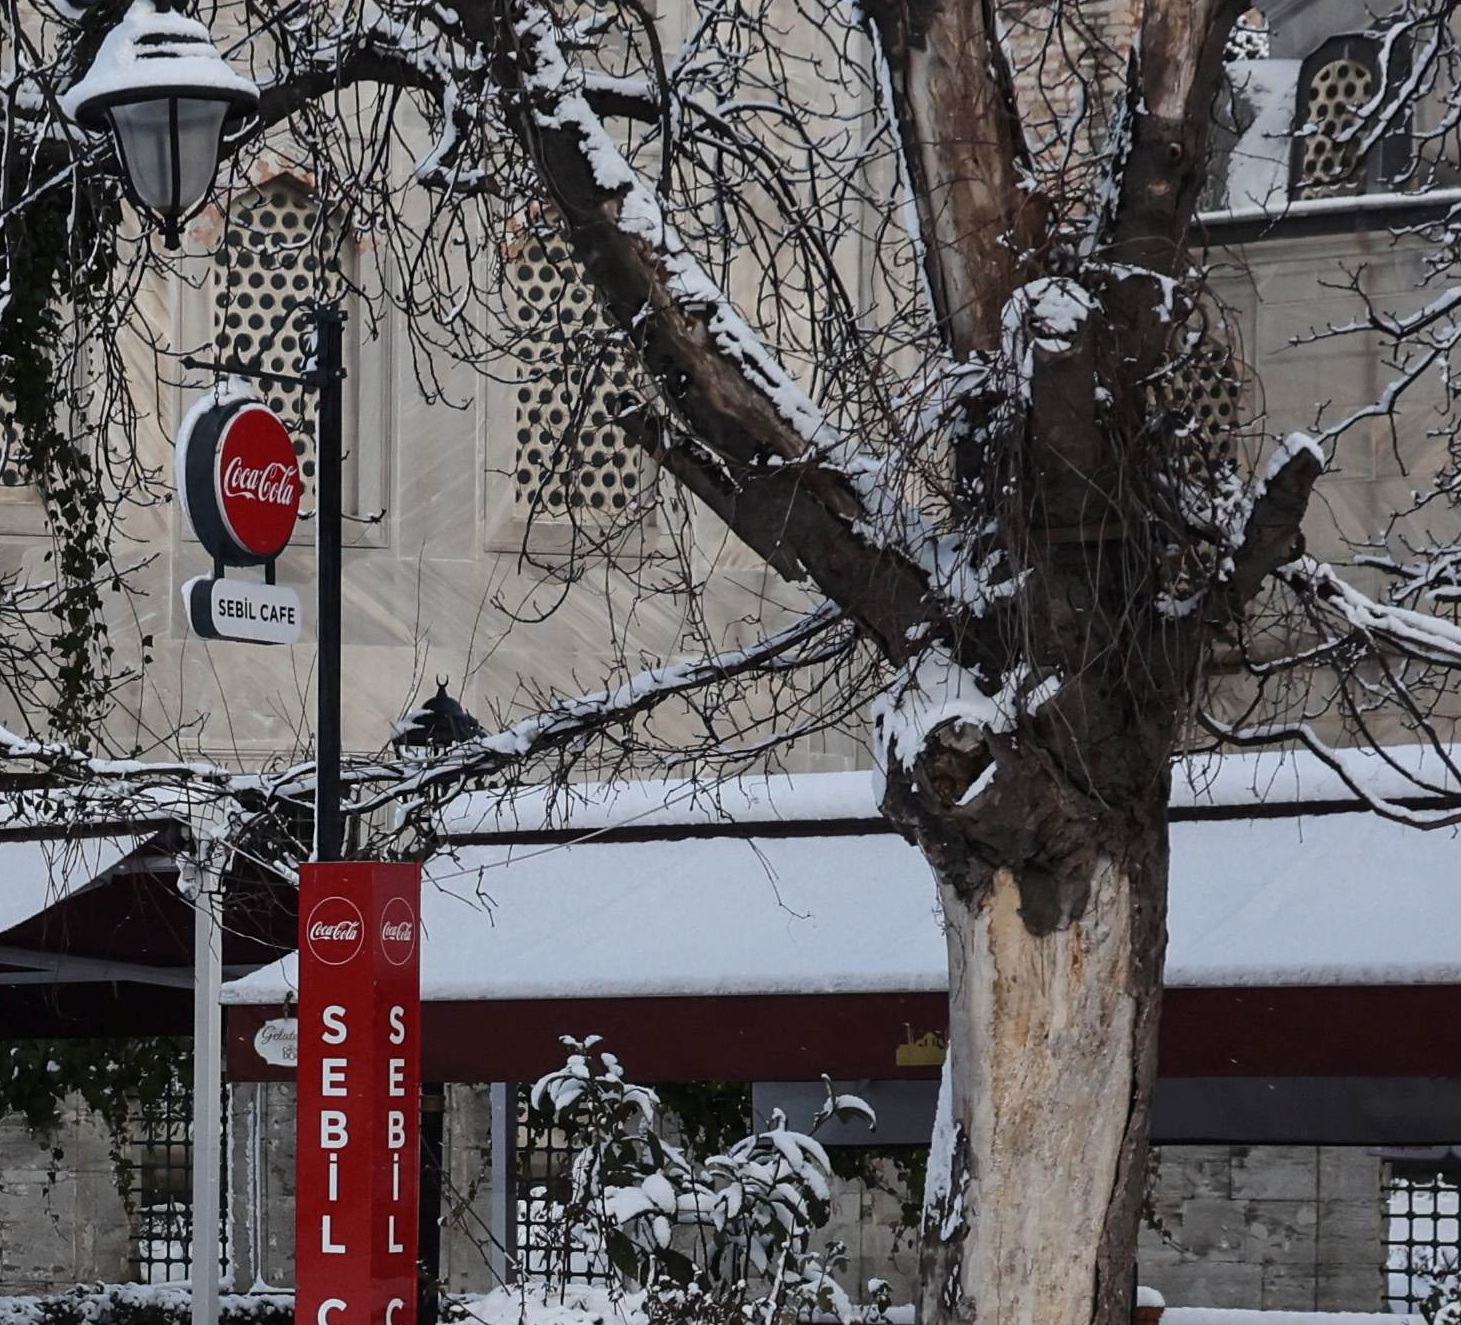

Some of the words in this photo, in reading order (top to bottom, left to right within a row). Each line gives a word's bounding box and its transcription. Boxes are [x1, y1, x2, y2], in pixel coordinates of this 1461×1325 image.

[223, 456, 297, 505] Coca-Cola
[218, 597, 257, 621] SEBİL
[260, 603, 296, 625] CAFE
[310, 921, 360, 941] Coca-Cola
[382, 921, 412, 941] Coca-Cola
[320, 1004, 349, 1254] SEBİL
[388, 1005, 406, 1254] SEBİL
